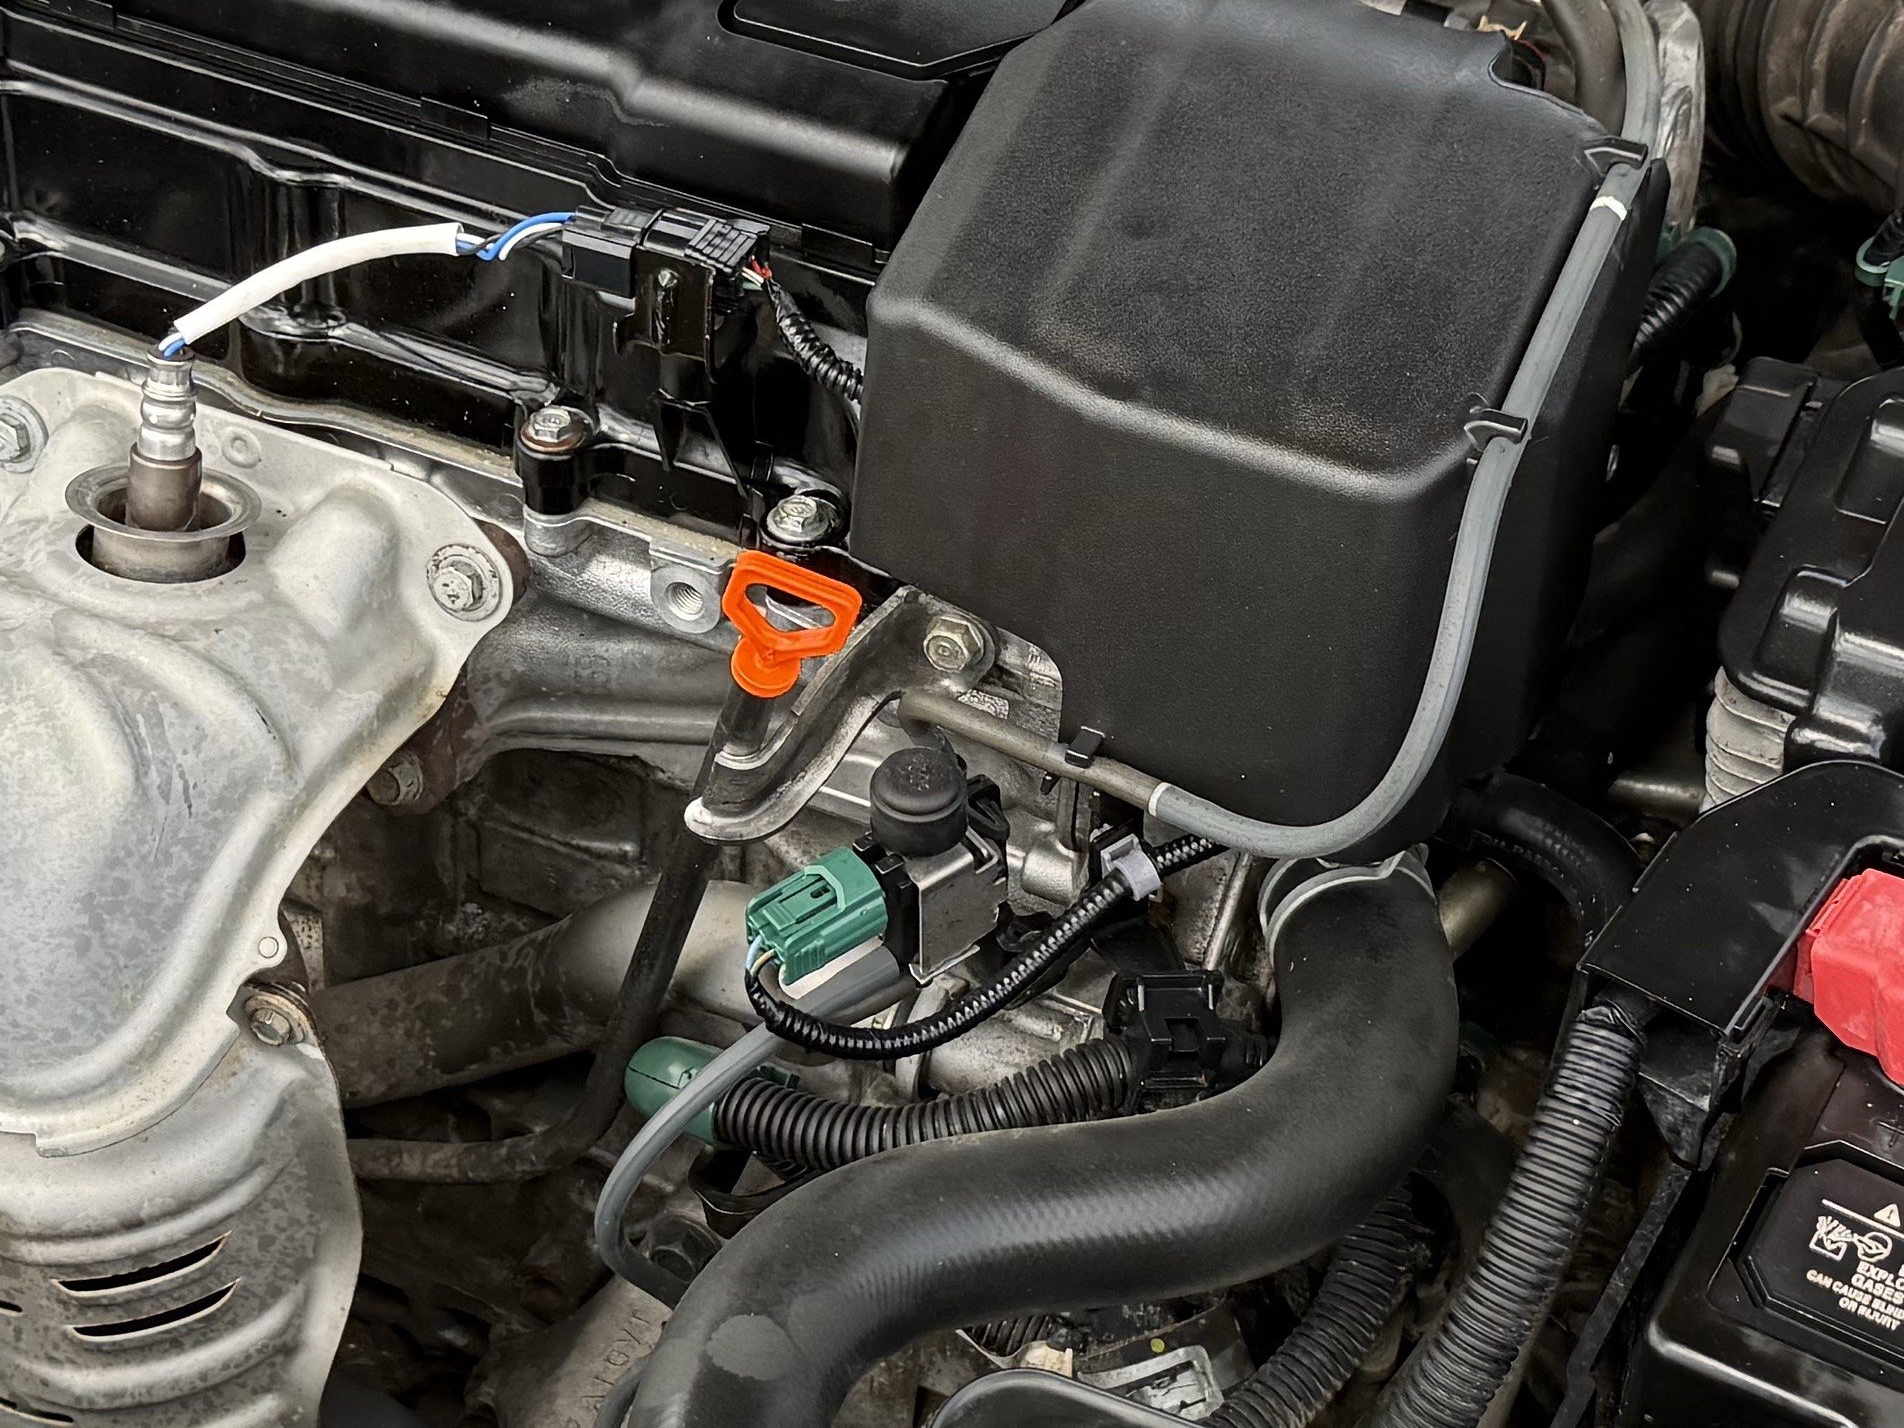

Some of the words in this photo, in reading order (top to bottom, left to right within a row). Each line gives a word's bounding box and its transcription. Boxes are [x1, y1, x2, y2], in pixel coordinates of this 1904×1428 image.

[1806, 1269, 1833, 1289] CAN
[1832, 1279, 1870, 1305] CAUSE
[1851, 1274, 1904, 1305] GASES
[1838, 1296, 1859, 1312] OR
